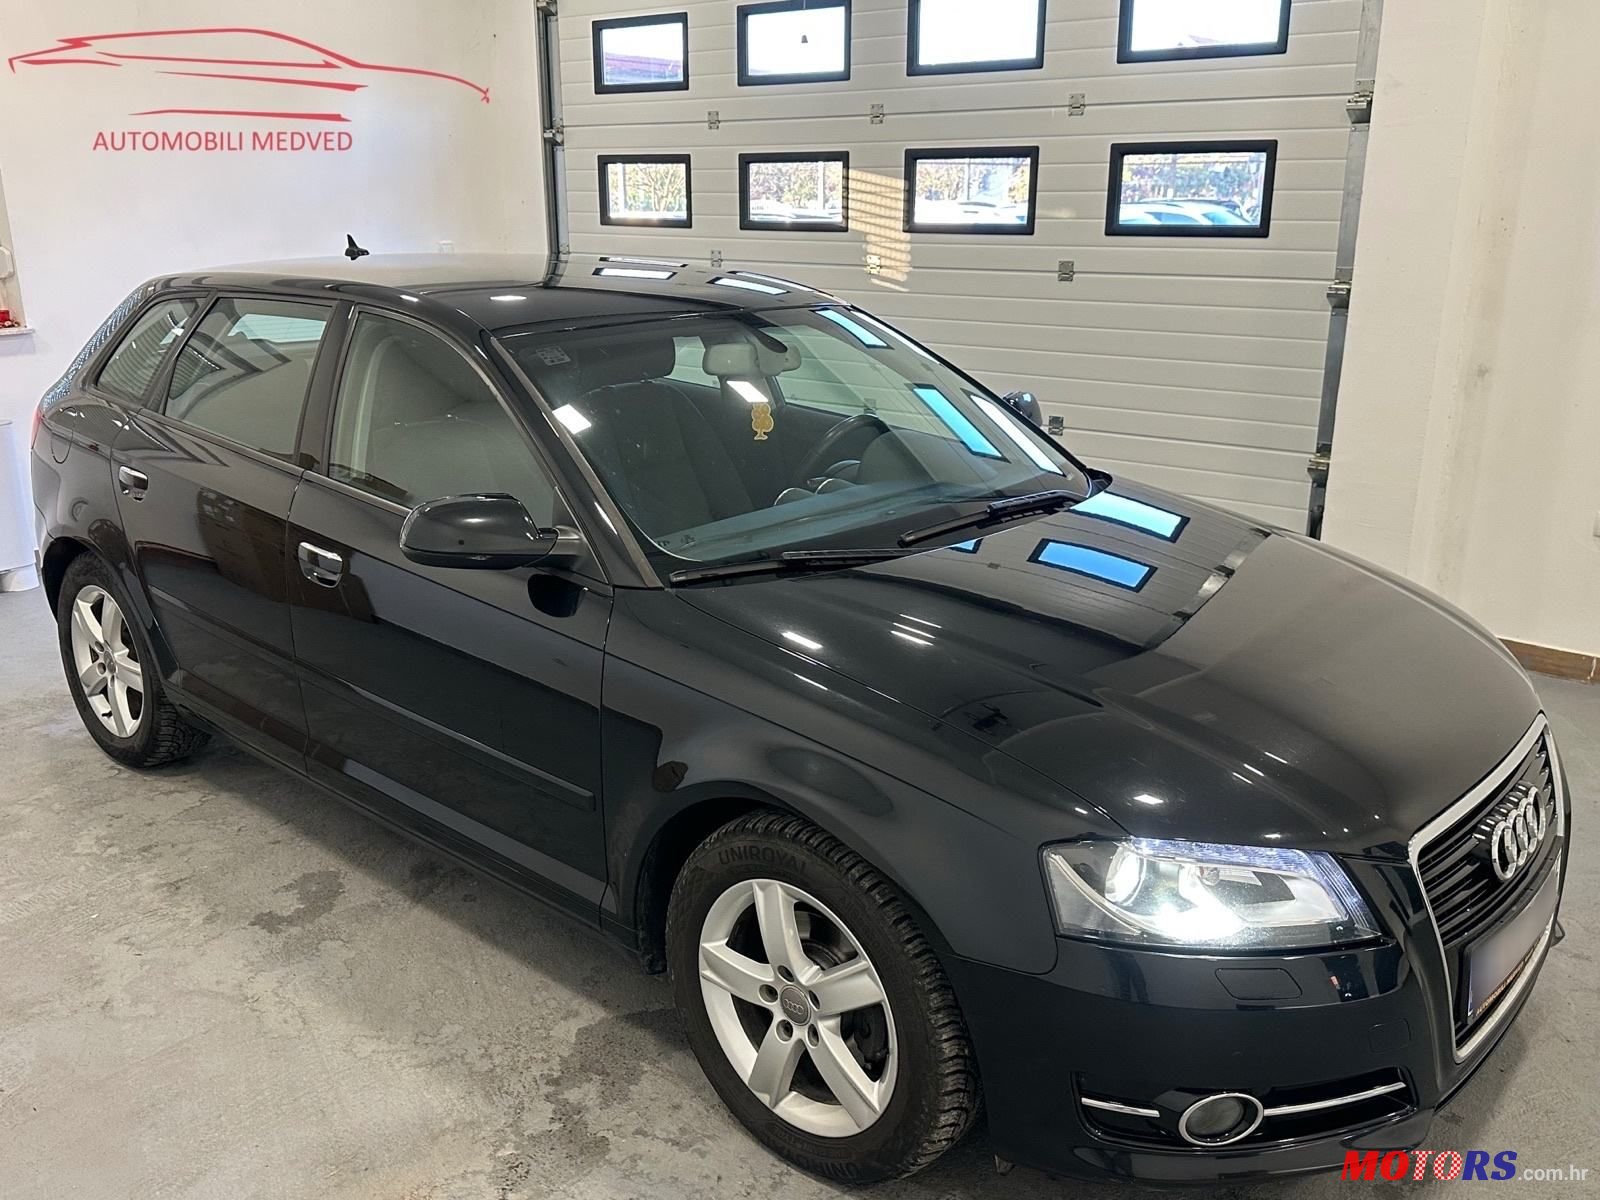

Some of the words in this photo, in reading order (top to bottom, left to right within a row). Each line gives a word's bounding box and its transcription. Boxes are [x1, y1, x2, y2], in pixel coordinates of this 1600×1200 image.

[92, 131, 244, 152] AUTOMOBILI
[251, 131, 353, 152] MEDVED
[718, 845, 807, 874] UNIROYAL
